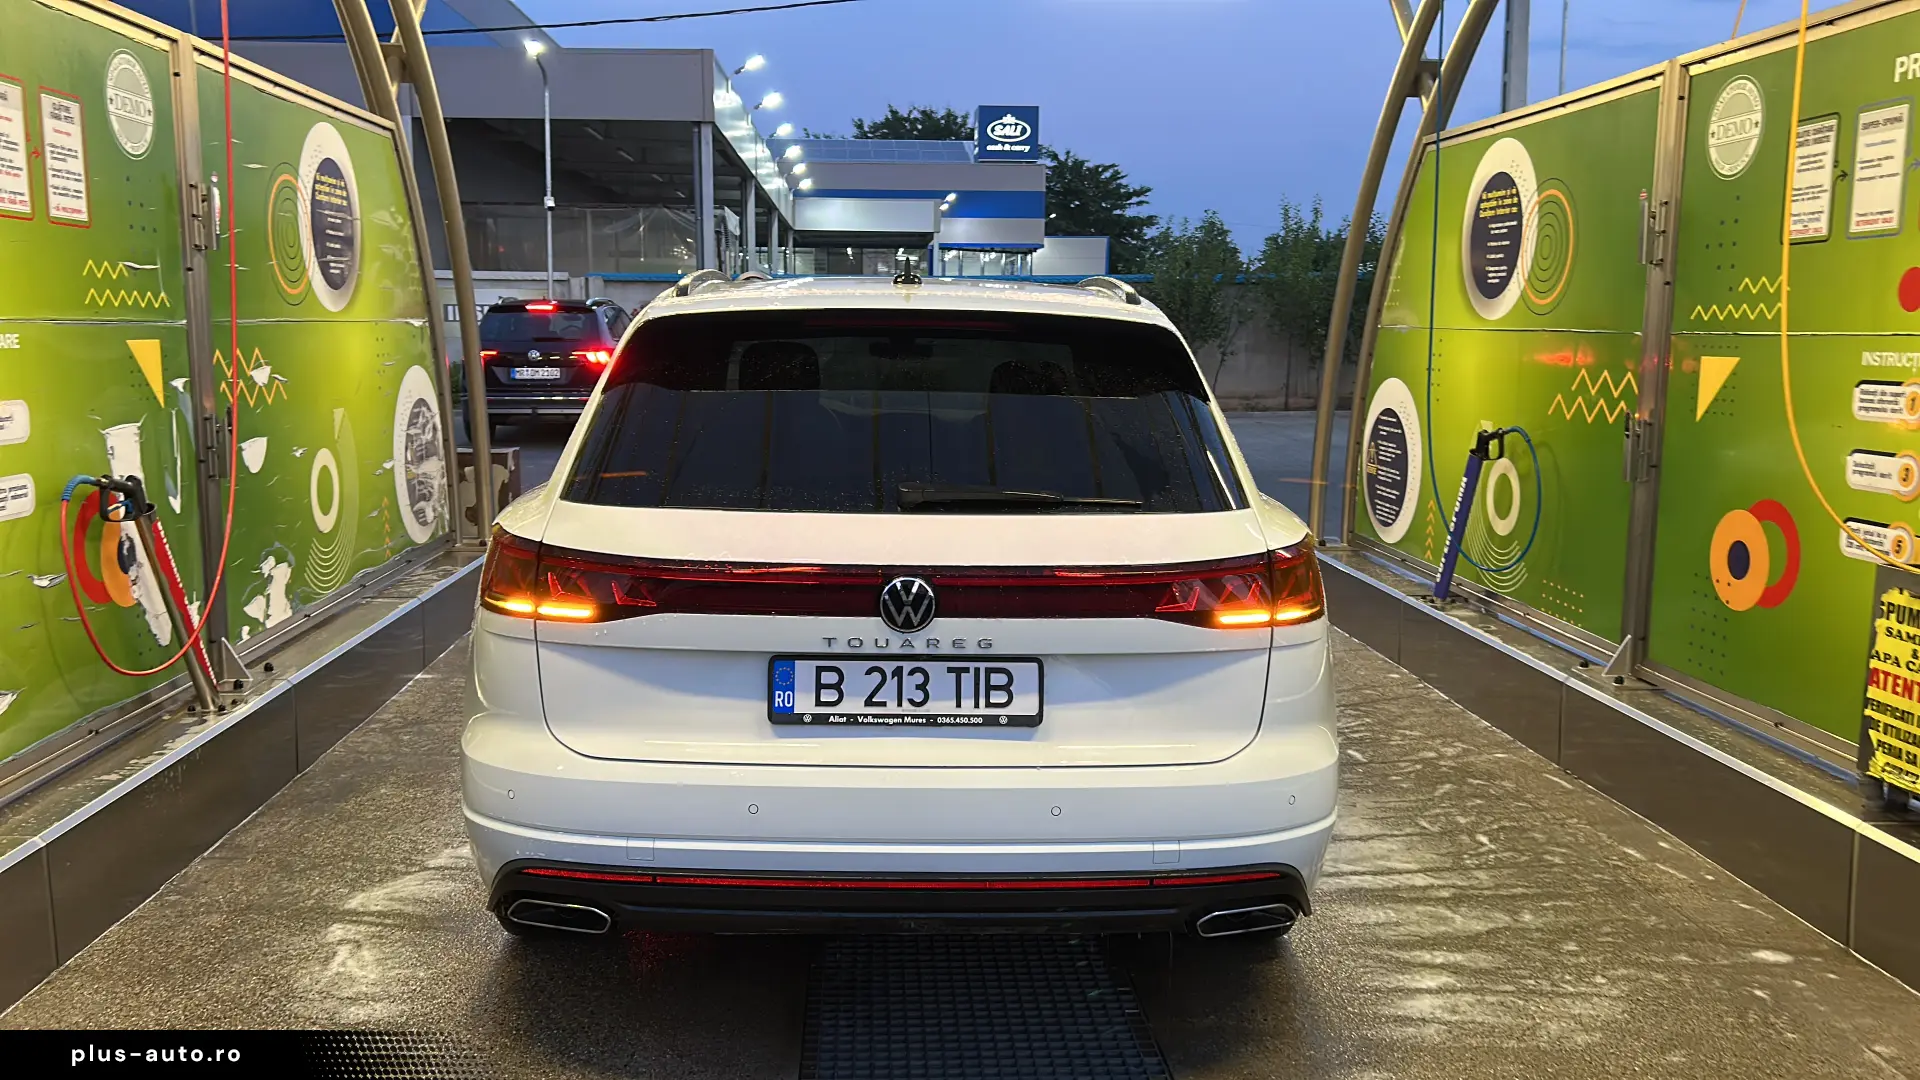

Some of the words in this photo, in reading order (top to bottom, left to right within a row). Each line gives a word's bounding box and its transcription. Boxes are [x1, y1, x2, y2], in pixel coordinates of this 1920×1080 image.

[114, 93, 146, 118] DEMO
[1716, 118, 1752, 140] DEMO
[822, 637, 993, 649] TOUAREG
[1870, 649, 1902, 668] APA
[814, 665, 845, 707] B
[864, 665, 930, 708] 213
[947, 666, 1014, 708] TIB
[774, 690, 794, 708] RO
[829, 716, 847, 724] Aliat
[857, 716, 903, 726] Volkswagen
[904, 716, 926, 724] Mures
[937, 716, 984, 725] 0365.450.500
